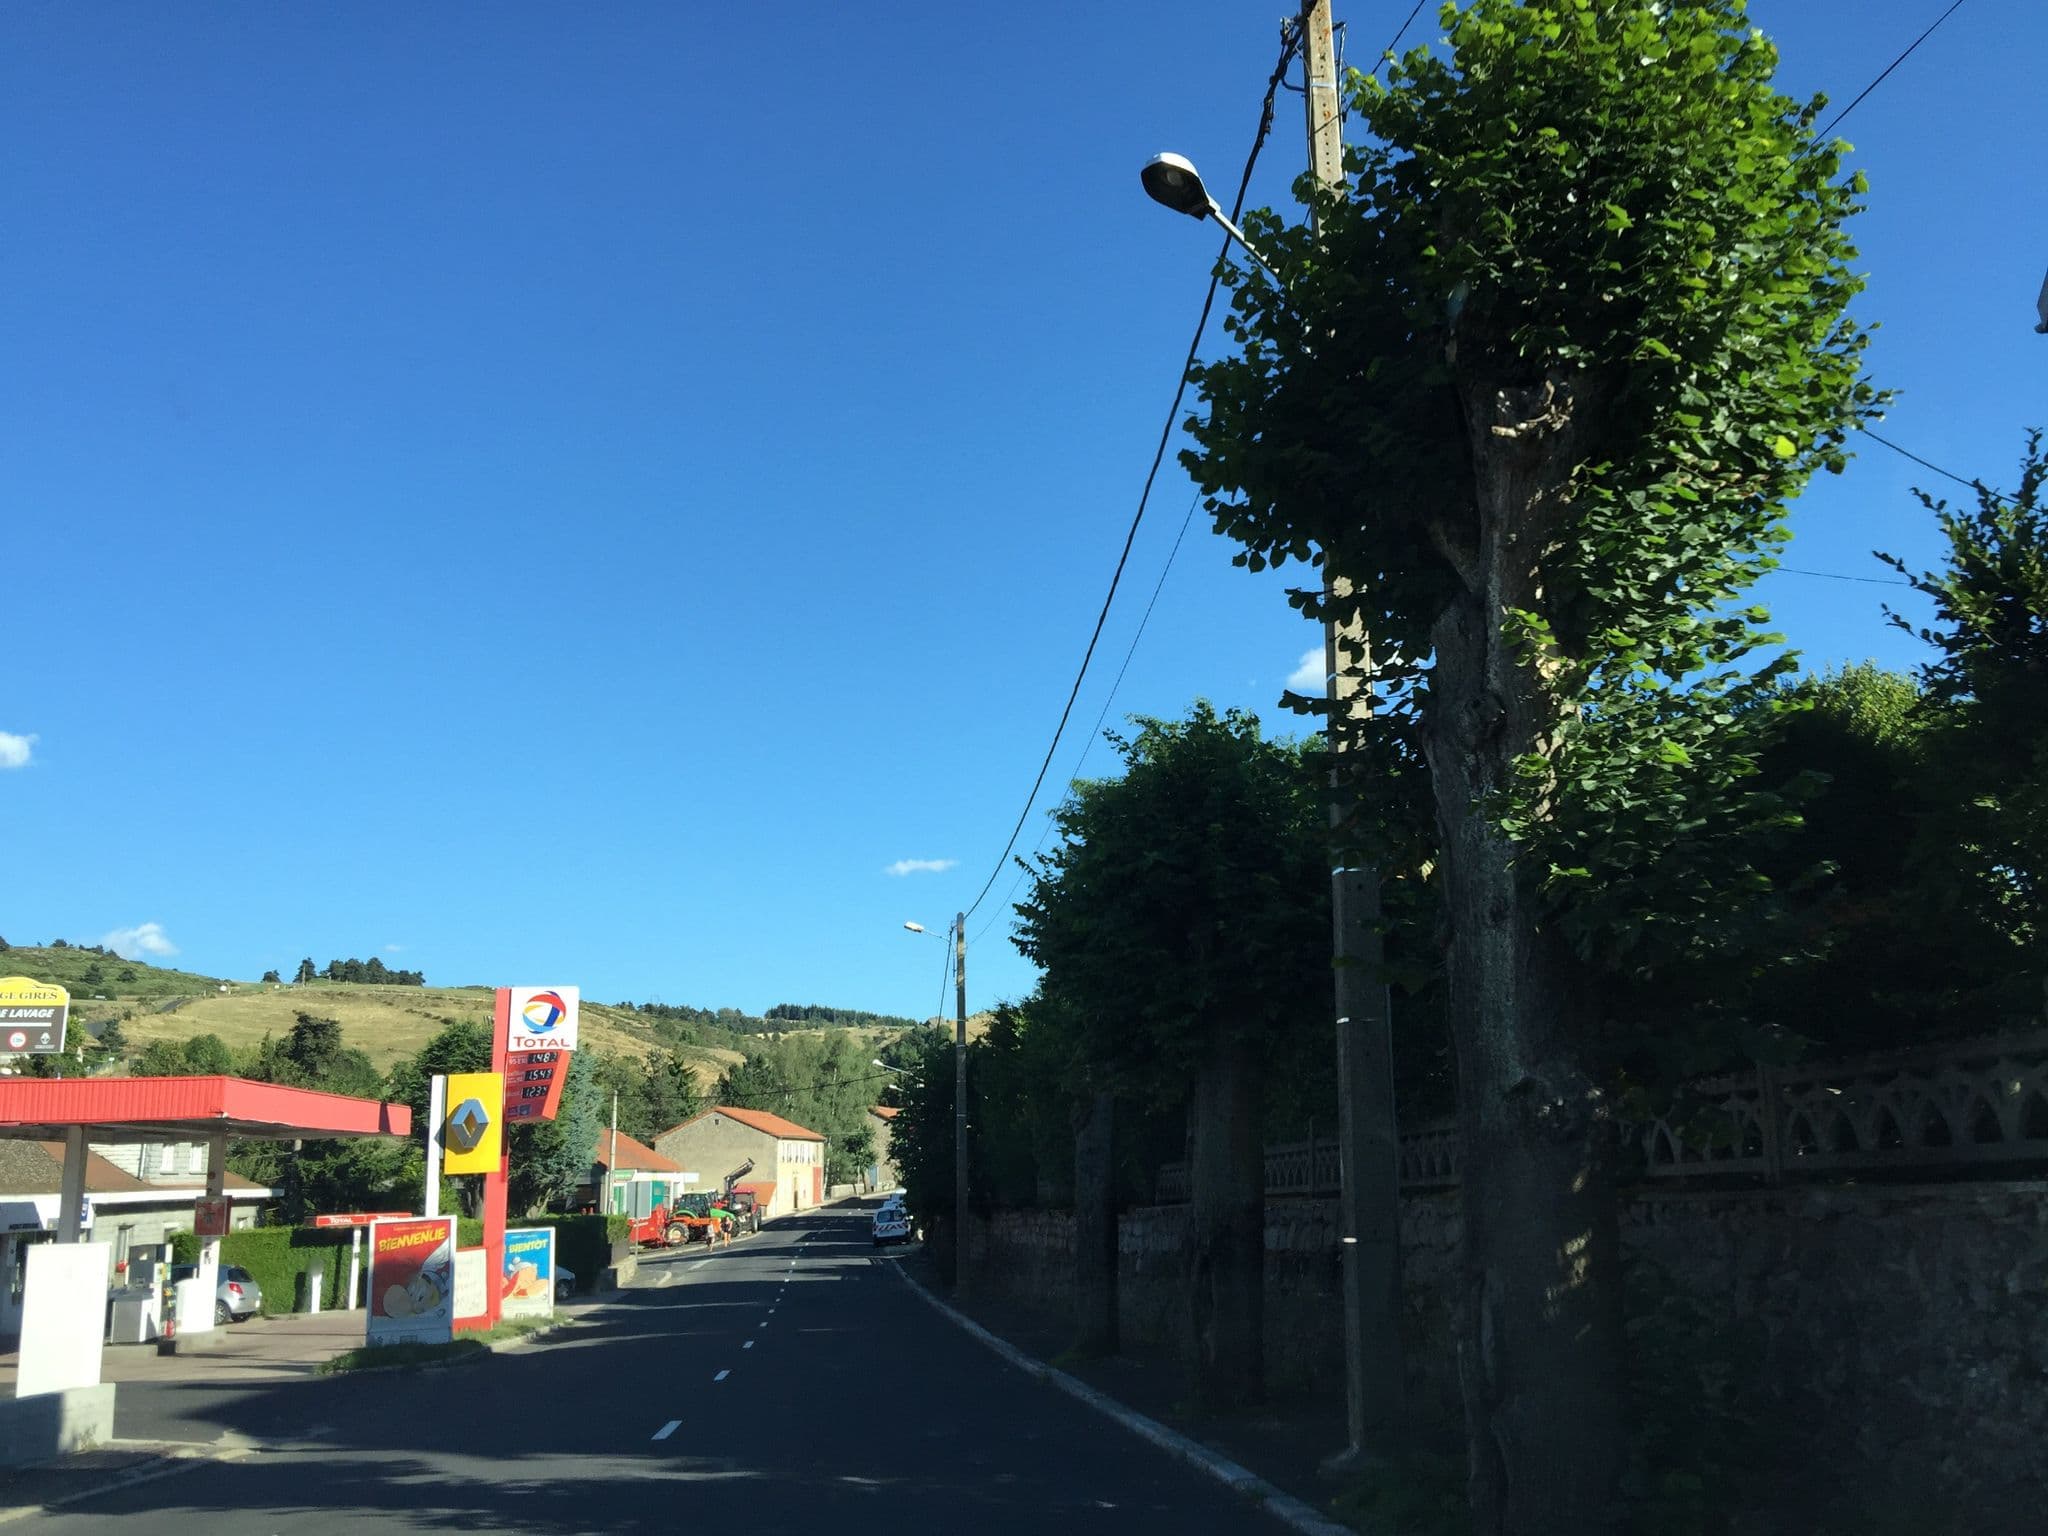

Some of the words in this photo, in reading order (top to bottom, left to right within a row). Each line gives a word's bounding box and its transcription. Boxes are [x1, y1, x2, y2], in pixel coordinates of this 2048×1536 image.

[19, 991, 58, 1000] GIRES
[9, 1008, 55, 1018] LAVAGE
[513, 1036, 570, 1048] TOTAL
[378, 1227, 446, 1252] BIENVENUE
